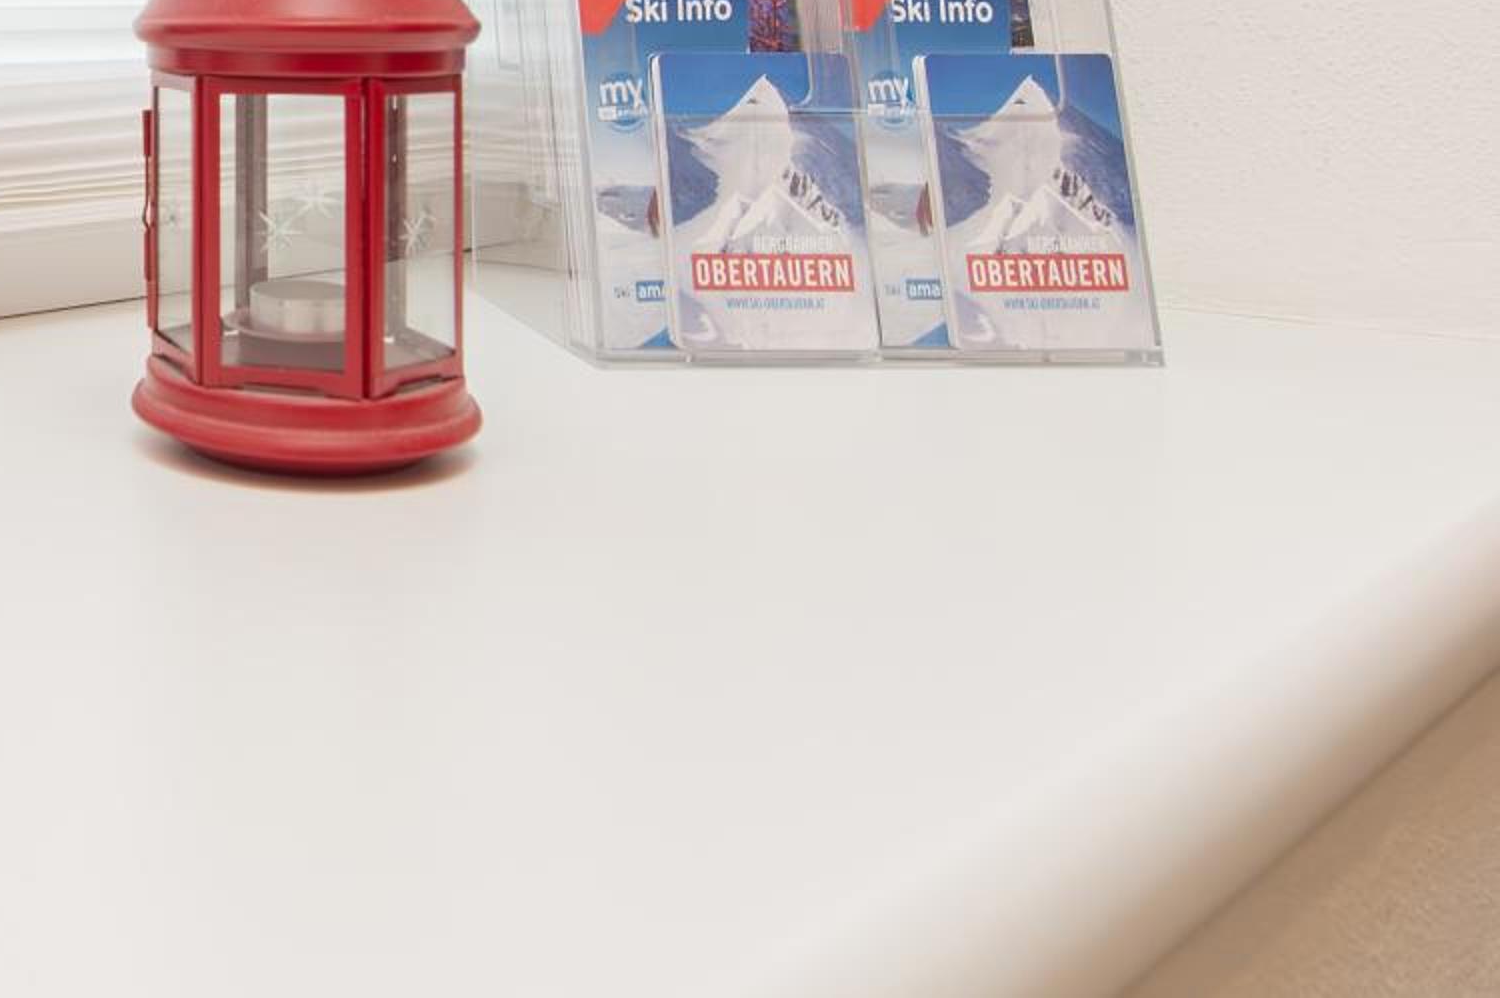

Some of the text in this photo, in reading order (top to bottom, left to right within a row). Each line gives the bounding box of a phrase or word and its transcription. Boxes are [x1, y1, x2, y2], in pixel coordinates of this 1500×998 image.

[599, 78, 644, 109] my
[868, 76, 909, 109] my
[695, 258, 851, 288] OBERTAUERN
[970, 258, 1125, 288] OBERTAUERN
